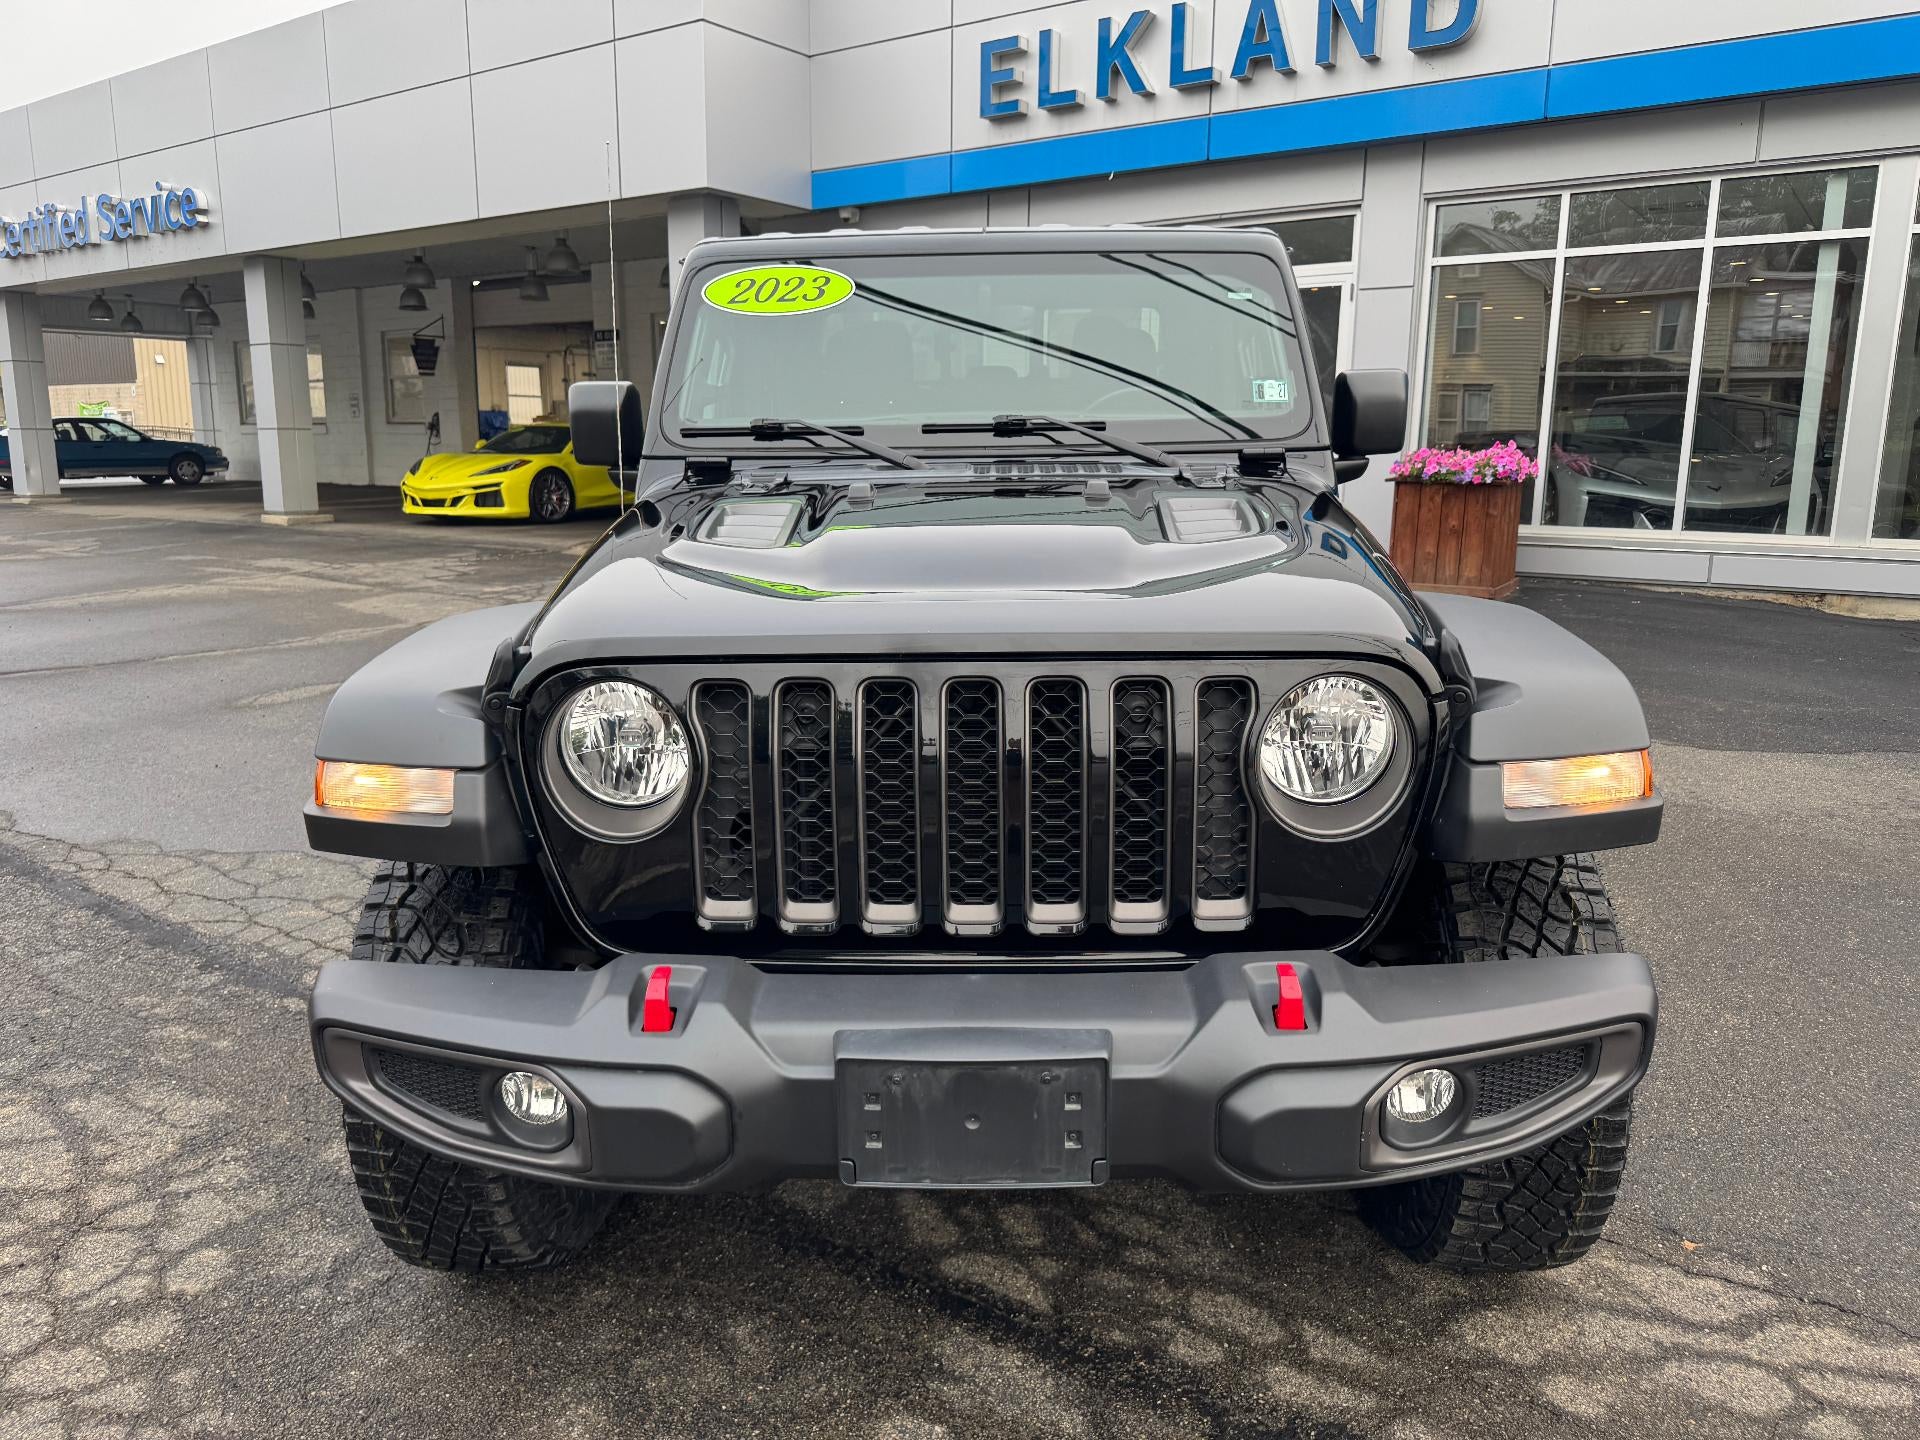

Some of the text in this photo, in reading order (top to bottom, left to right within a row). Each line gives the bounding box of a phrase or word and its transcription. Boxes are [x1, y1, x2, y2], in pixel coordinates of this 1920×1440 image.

[980, 0, 1480, 121] ELKLAND
[97, 181, 201, 242] Service
[727, 275, 831, 305] 2023
